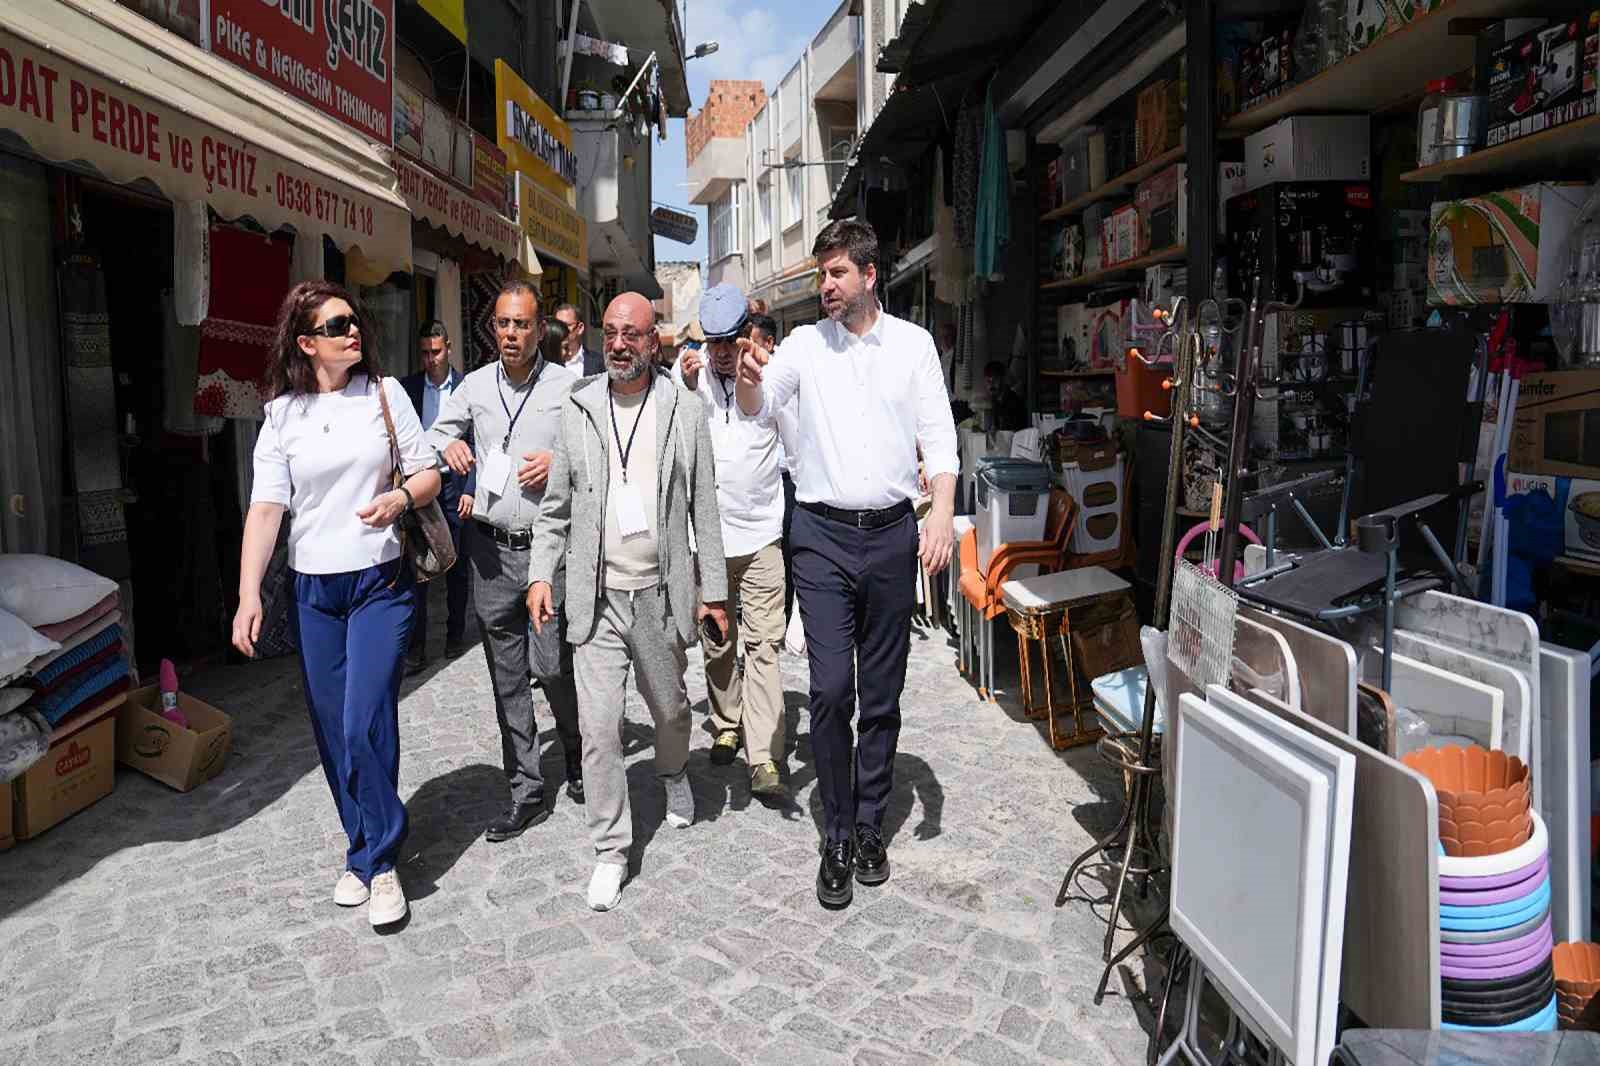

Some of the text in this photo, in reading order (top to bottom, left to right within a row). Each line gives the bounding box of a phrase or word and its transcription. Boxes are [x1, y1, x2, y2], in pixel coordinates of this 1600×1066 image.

[256, 38, 268, 70] &
[335, 85, 387, 137] TAKIMLARI
[70, 79, 160, 162] PERDE
[168, 131, 193, 173] ve
[202, 135, 257, 198] ÇEYİZ
[277, 172, 311, 216] 0538
[316, 187, 338, 224] 677
[341, 198, 356, 231] 74
[360, 206, 373, 237] 18
